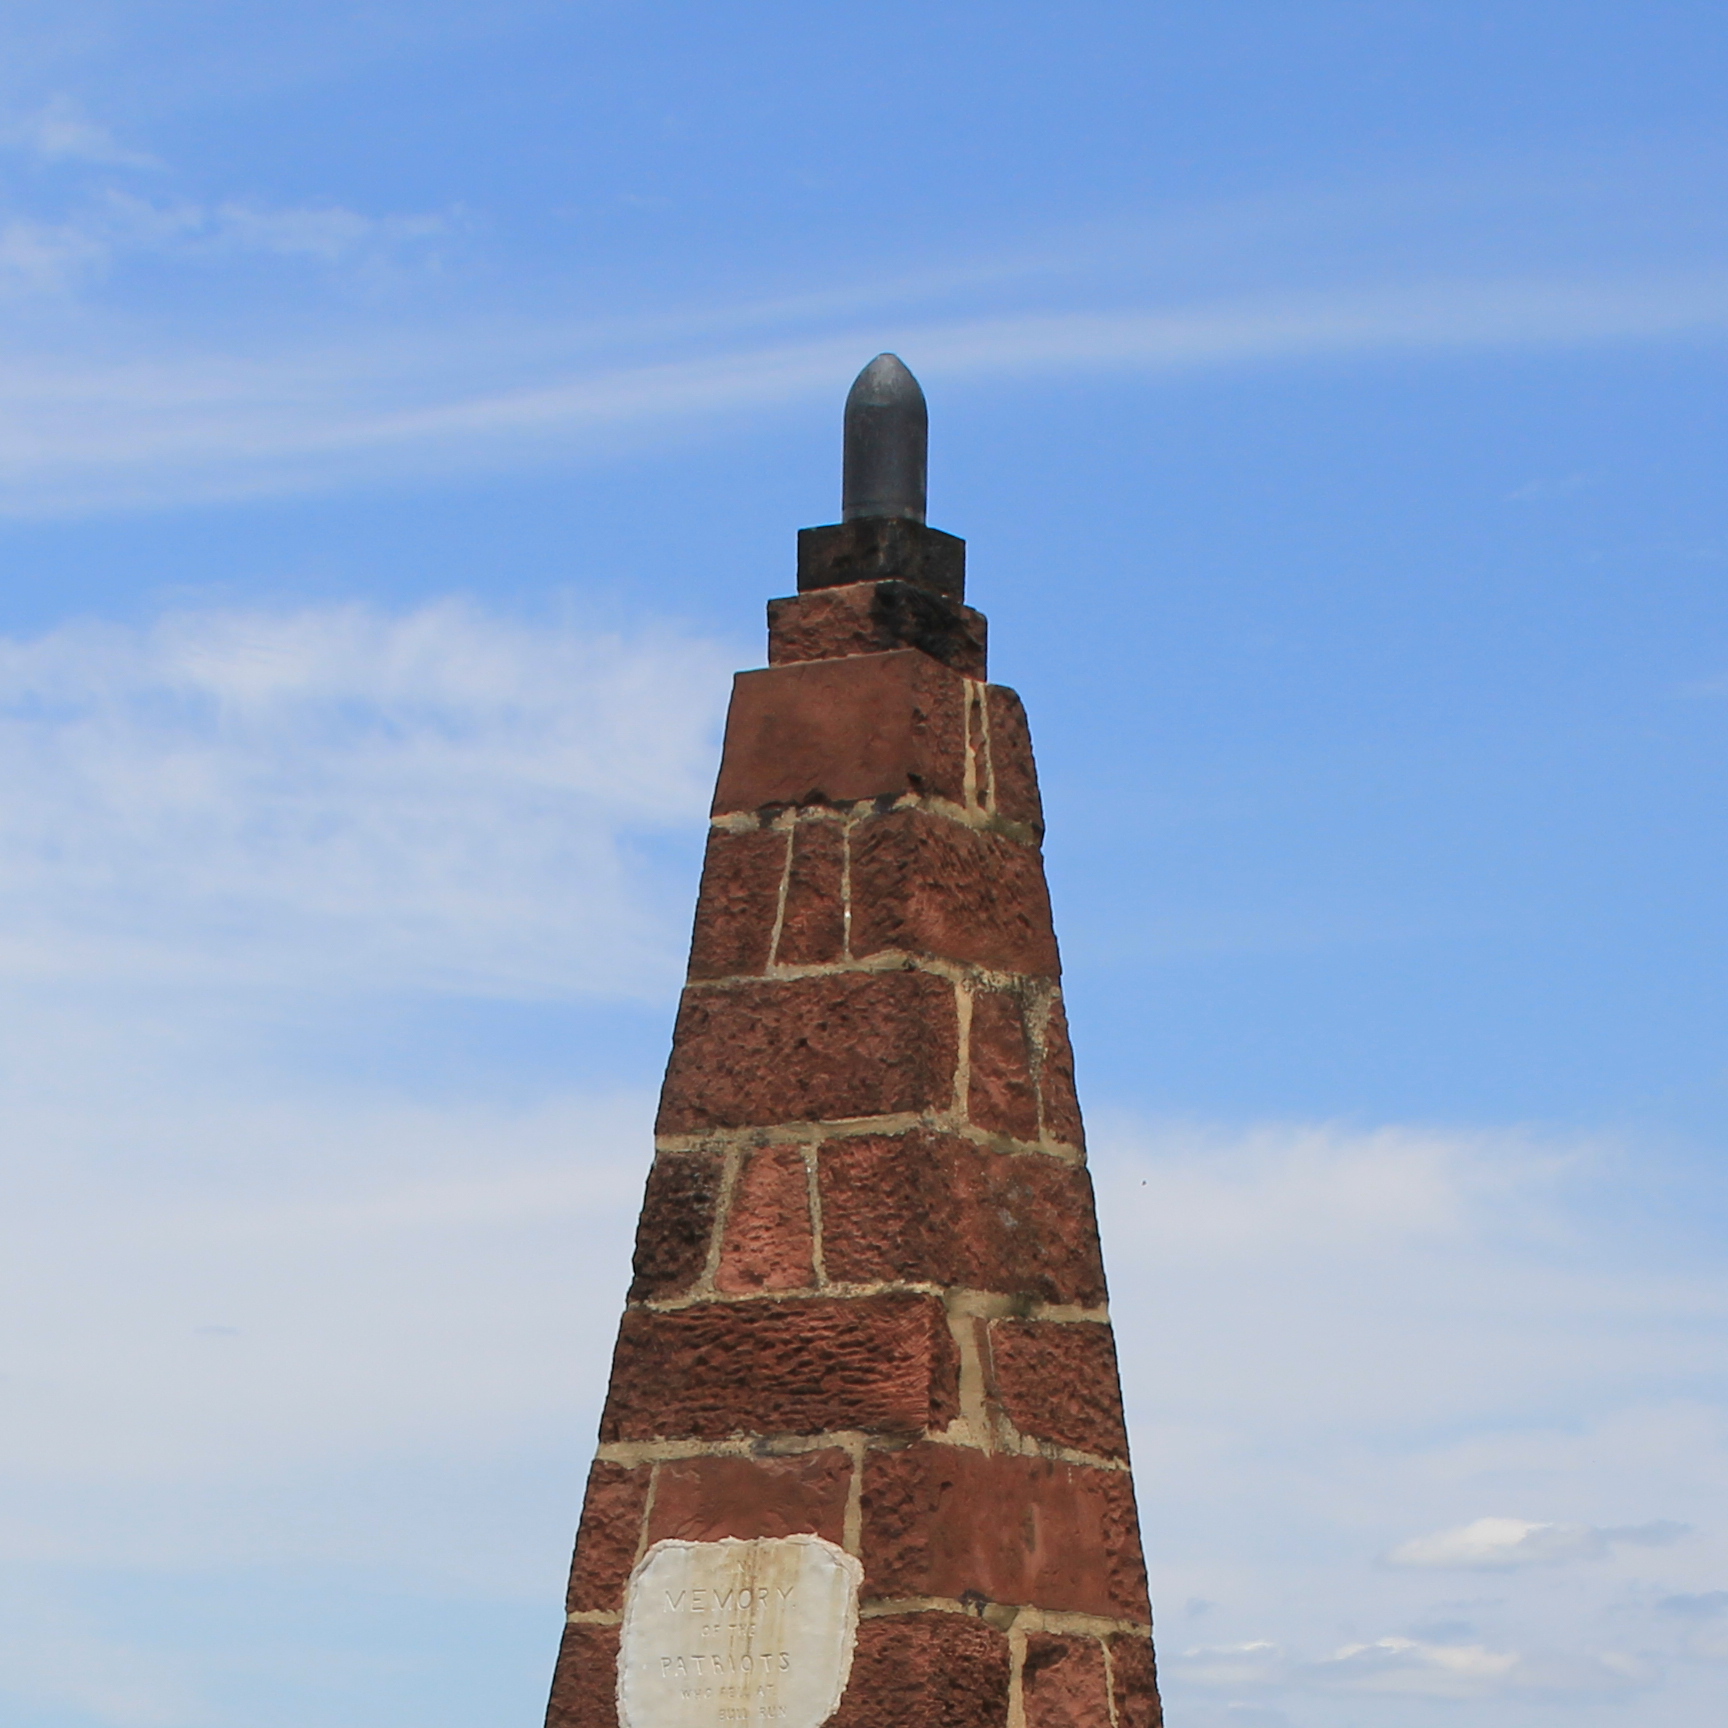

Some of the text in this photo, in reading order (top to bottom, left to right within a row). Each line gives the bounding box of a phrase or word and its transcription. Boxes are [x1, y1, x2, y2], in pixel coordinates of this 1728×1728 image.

[701, 1623, 756, 1637] OF THE
[660, 1652, 790, 1678] PATRIOTS
[681, 1688, 713, 1700] WHO
